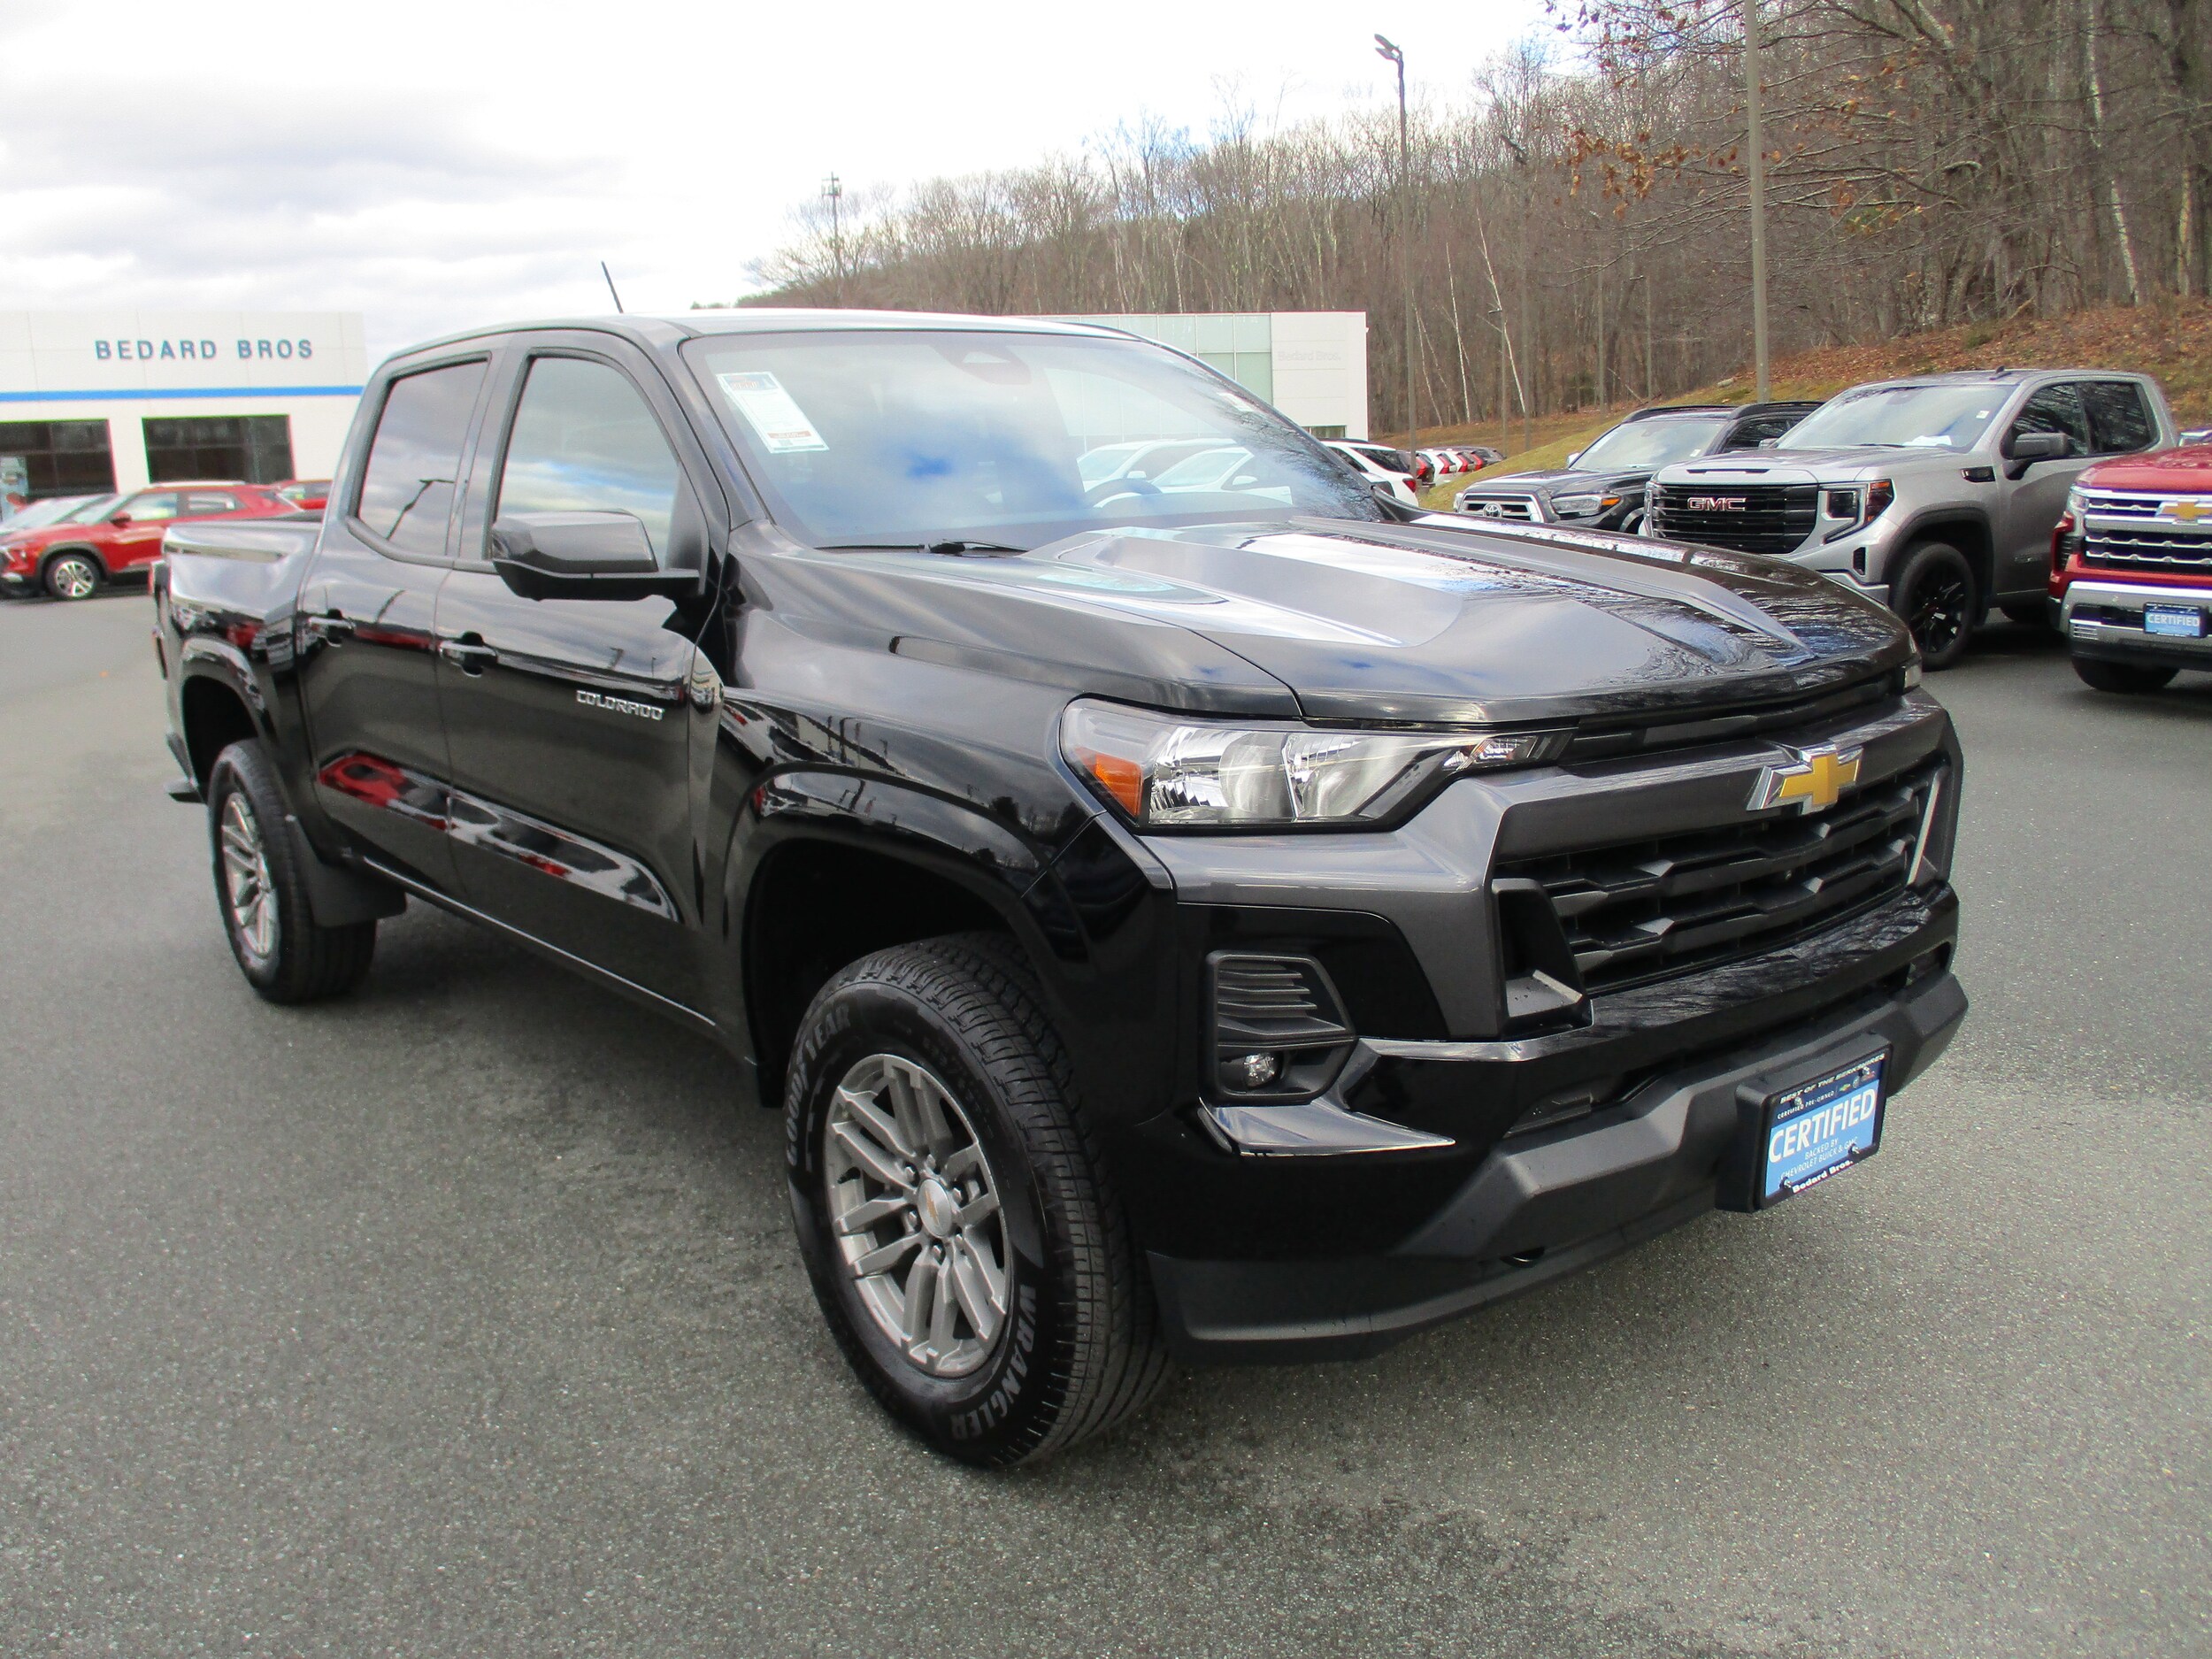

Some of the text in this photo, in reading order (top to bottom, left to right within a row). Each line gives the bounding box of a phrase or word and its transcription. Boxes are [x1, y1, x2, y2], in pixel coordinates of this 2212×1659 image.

[95, 339, 312, 360] BEDARD BROS
[1687, 496, 1747, 511] GMC
[2148, 613, 2200, 626] CERTIFIED
[576, 690, 664, 721] COLORADO
[787, 1000, 850, 1166] GOODYEAR
[1780, 1089, 1803, 1103] BEST
[1804, 1084, 1816, 1093] OF
[1818, 1076, 1835, 1087] THE
[1778, 1090, 1835, 1119] CERTIFIED PRE-OWNED
[1769, 1089, 1876, 1163] CERTIFIED
[1780, 1157, 1817, 1180] CHEVROLET
[1818, 1148, 1838, 1163] BUICK
[1805, 1138, 1839, 1160] BACKED BY
[1792, 1159, 1854, 1194] Bedard Bros.
[950, 1284, 1037, 1440] WRANGLER
